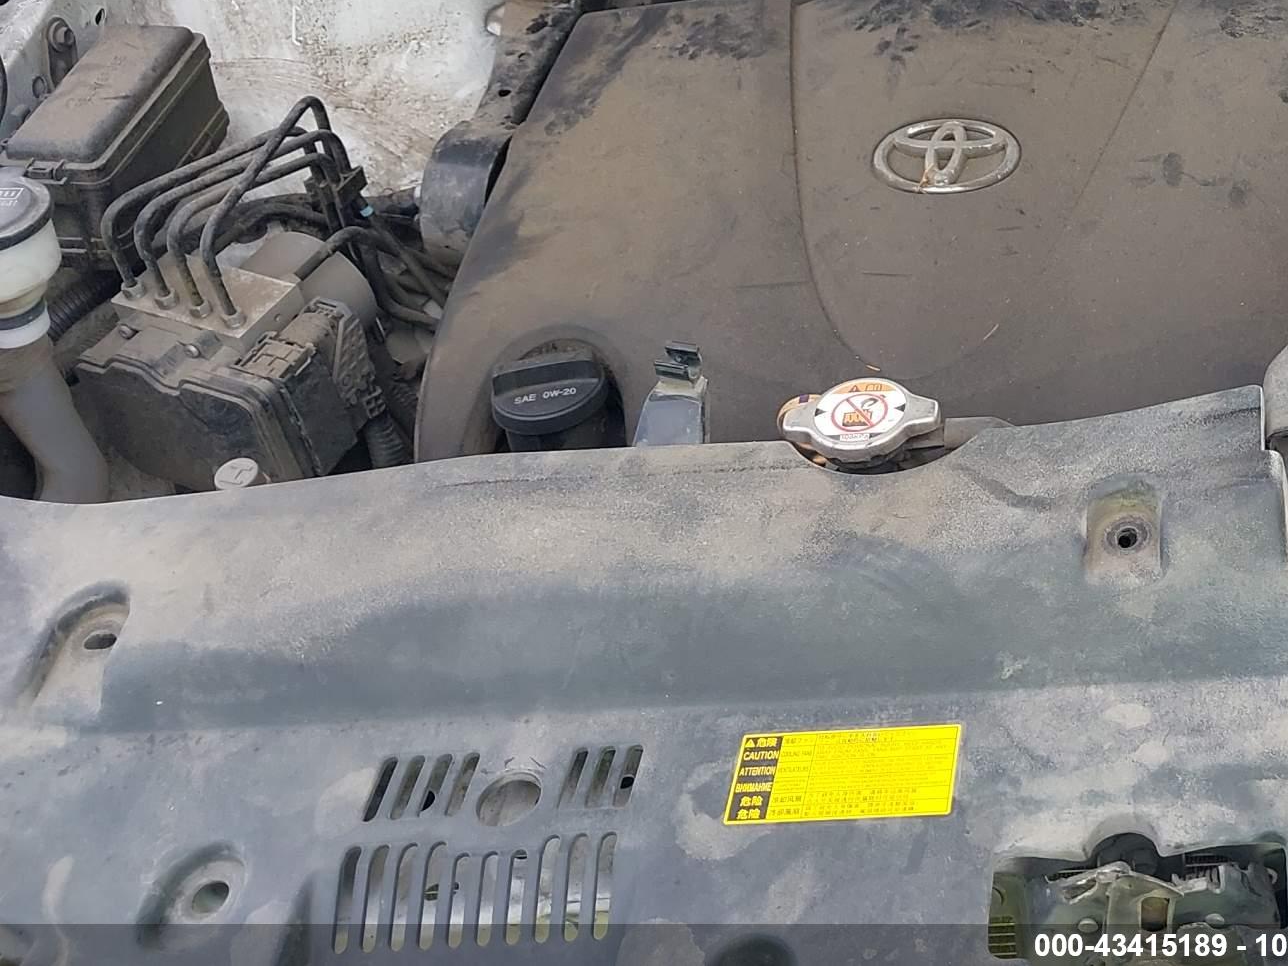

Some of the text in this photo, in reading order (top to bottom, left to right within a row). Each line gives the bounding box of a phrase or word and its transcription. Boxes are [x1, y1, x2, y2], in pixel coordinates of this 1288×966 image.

[513, 387, 577, 405] SAE 0W-20
[743, 750, 779, 761] CAUTION
[739, 766, 777, 776] ATTENTION
